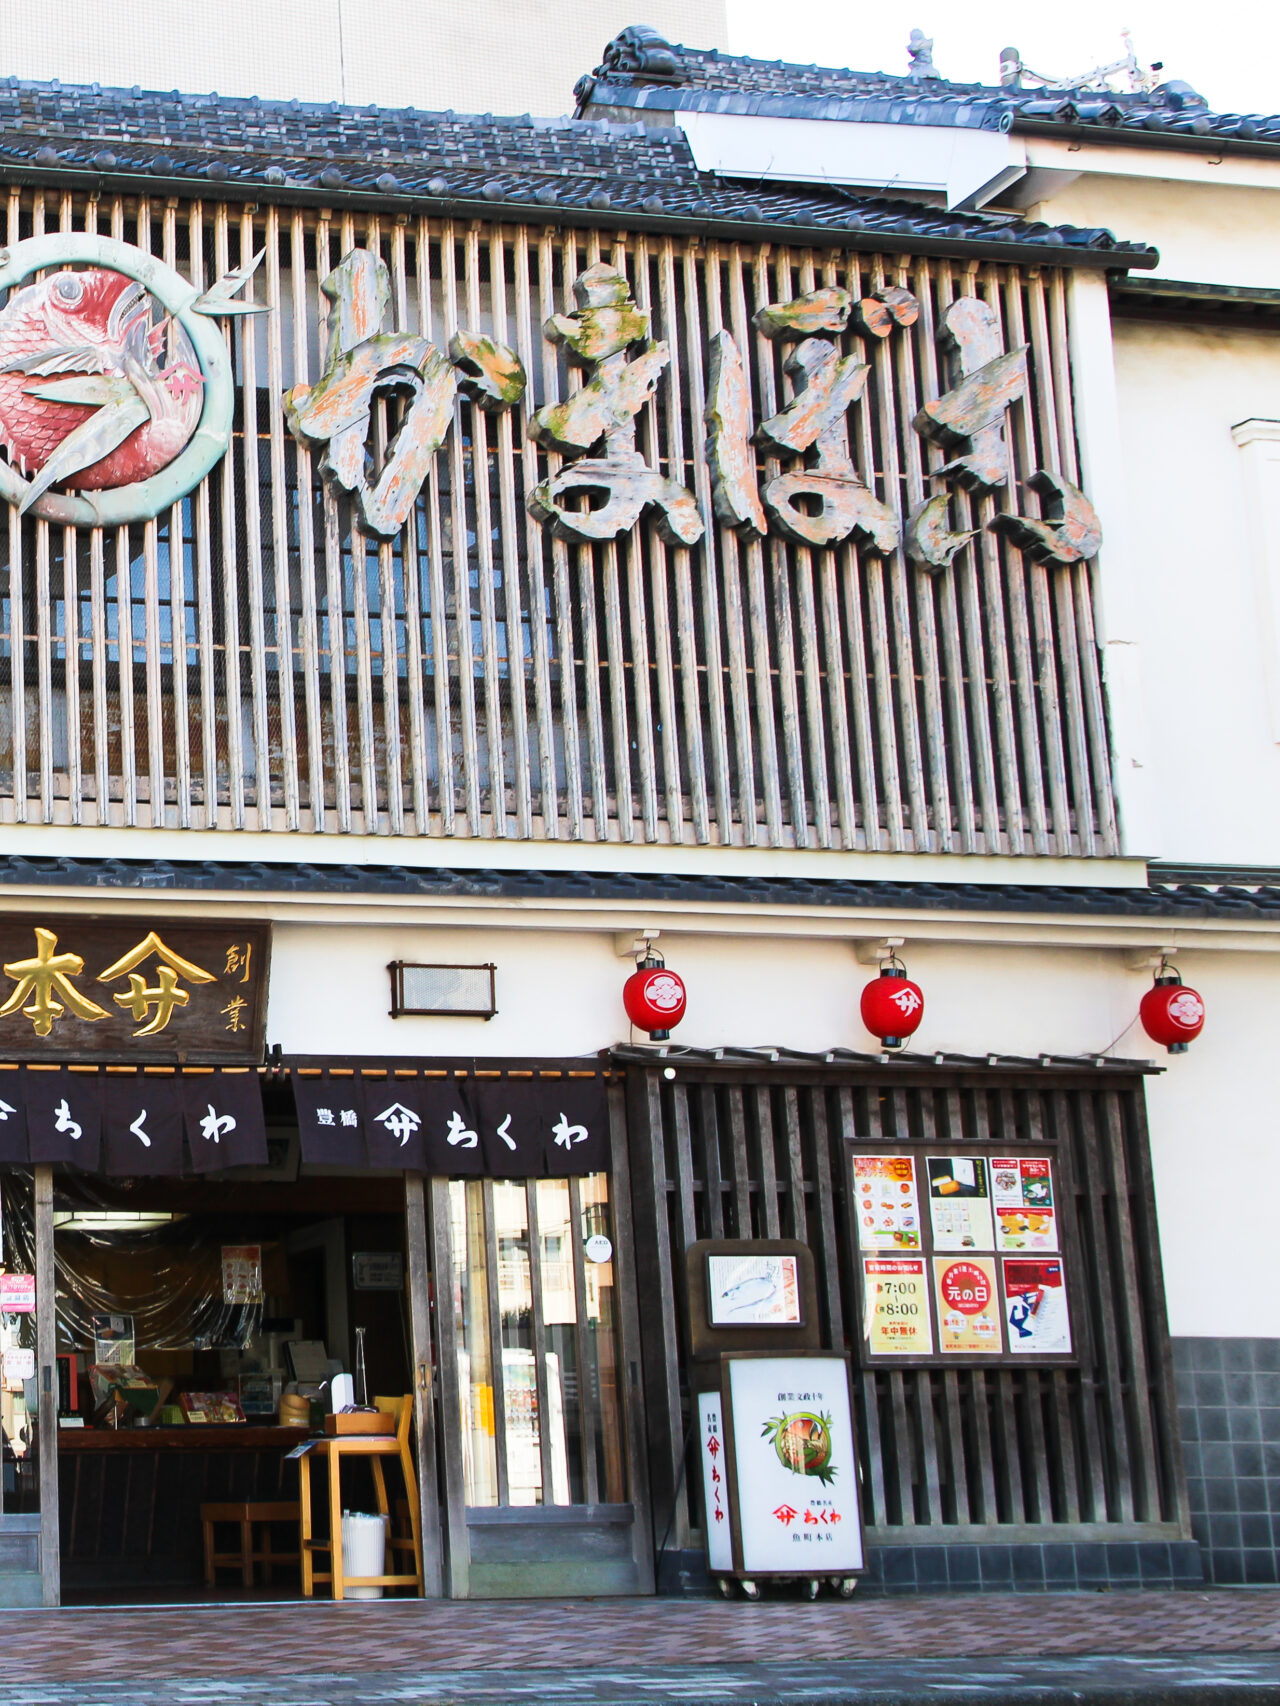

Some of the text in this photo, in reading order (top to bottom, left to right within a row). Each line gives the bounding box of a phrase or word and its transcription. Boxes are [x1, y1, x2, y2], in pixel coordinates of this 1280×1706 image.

[884, 1282, 917, 1294] 7:00
[947, 1286, 988, 1302] 元の日
[886, 1303, 918, 1316] 8:00
[880, 1326, 918, 1337] 年中無休
